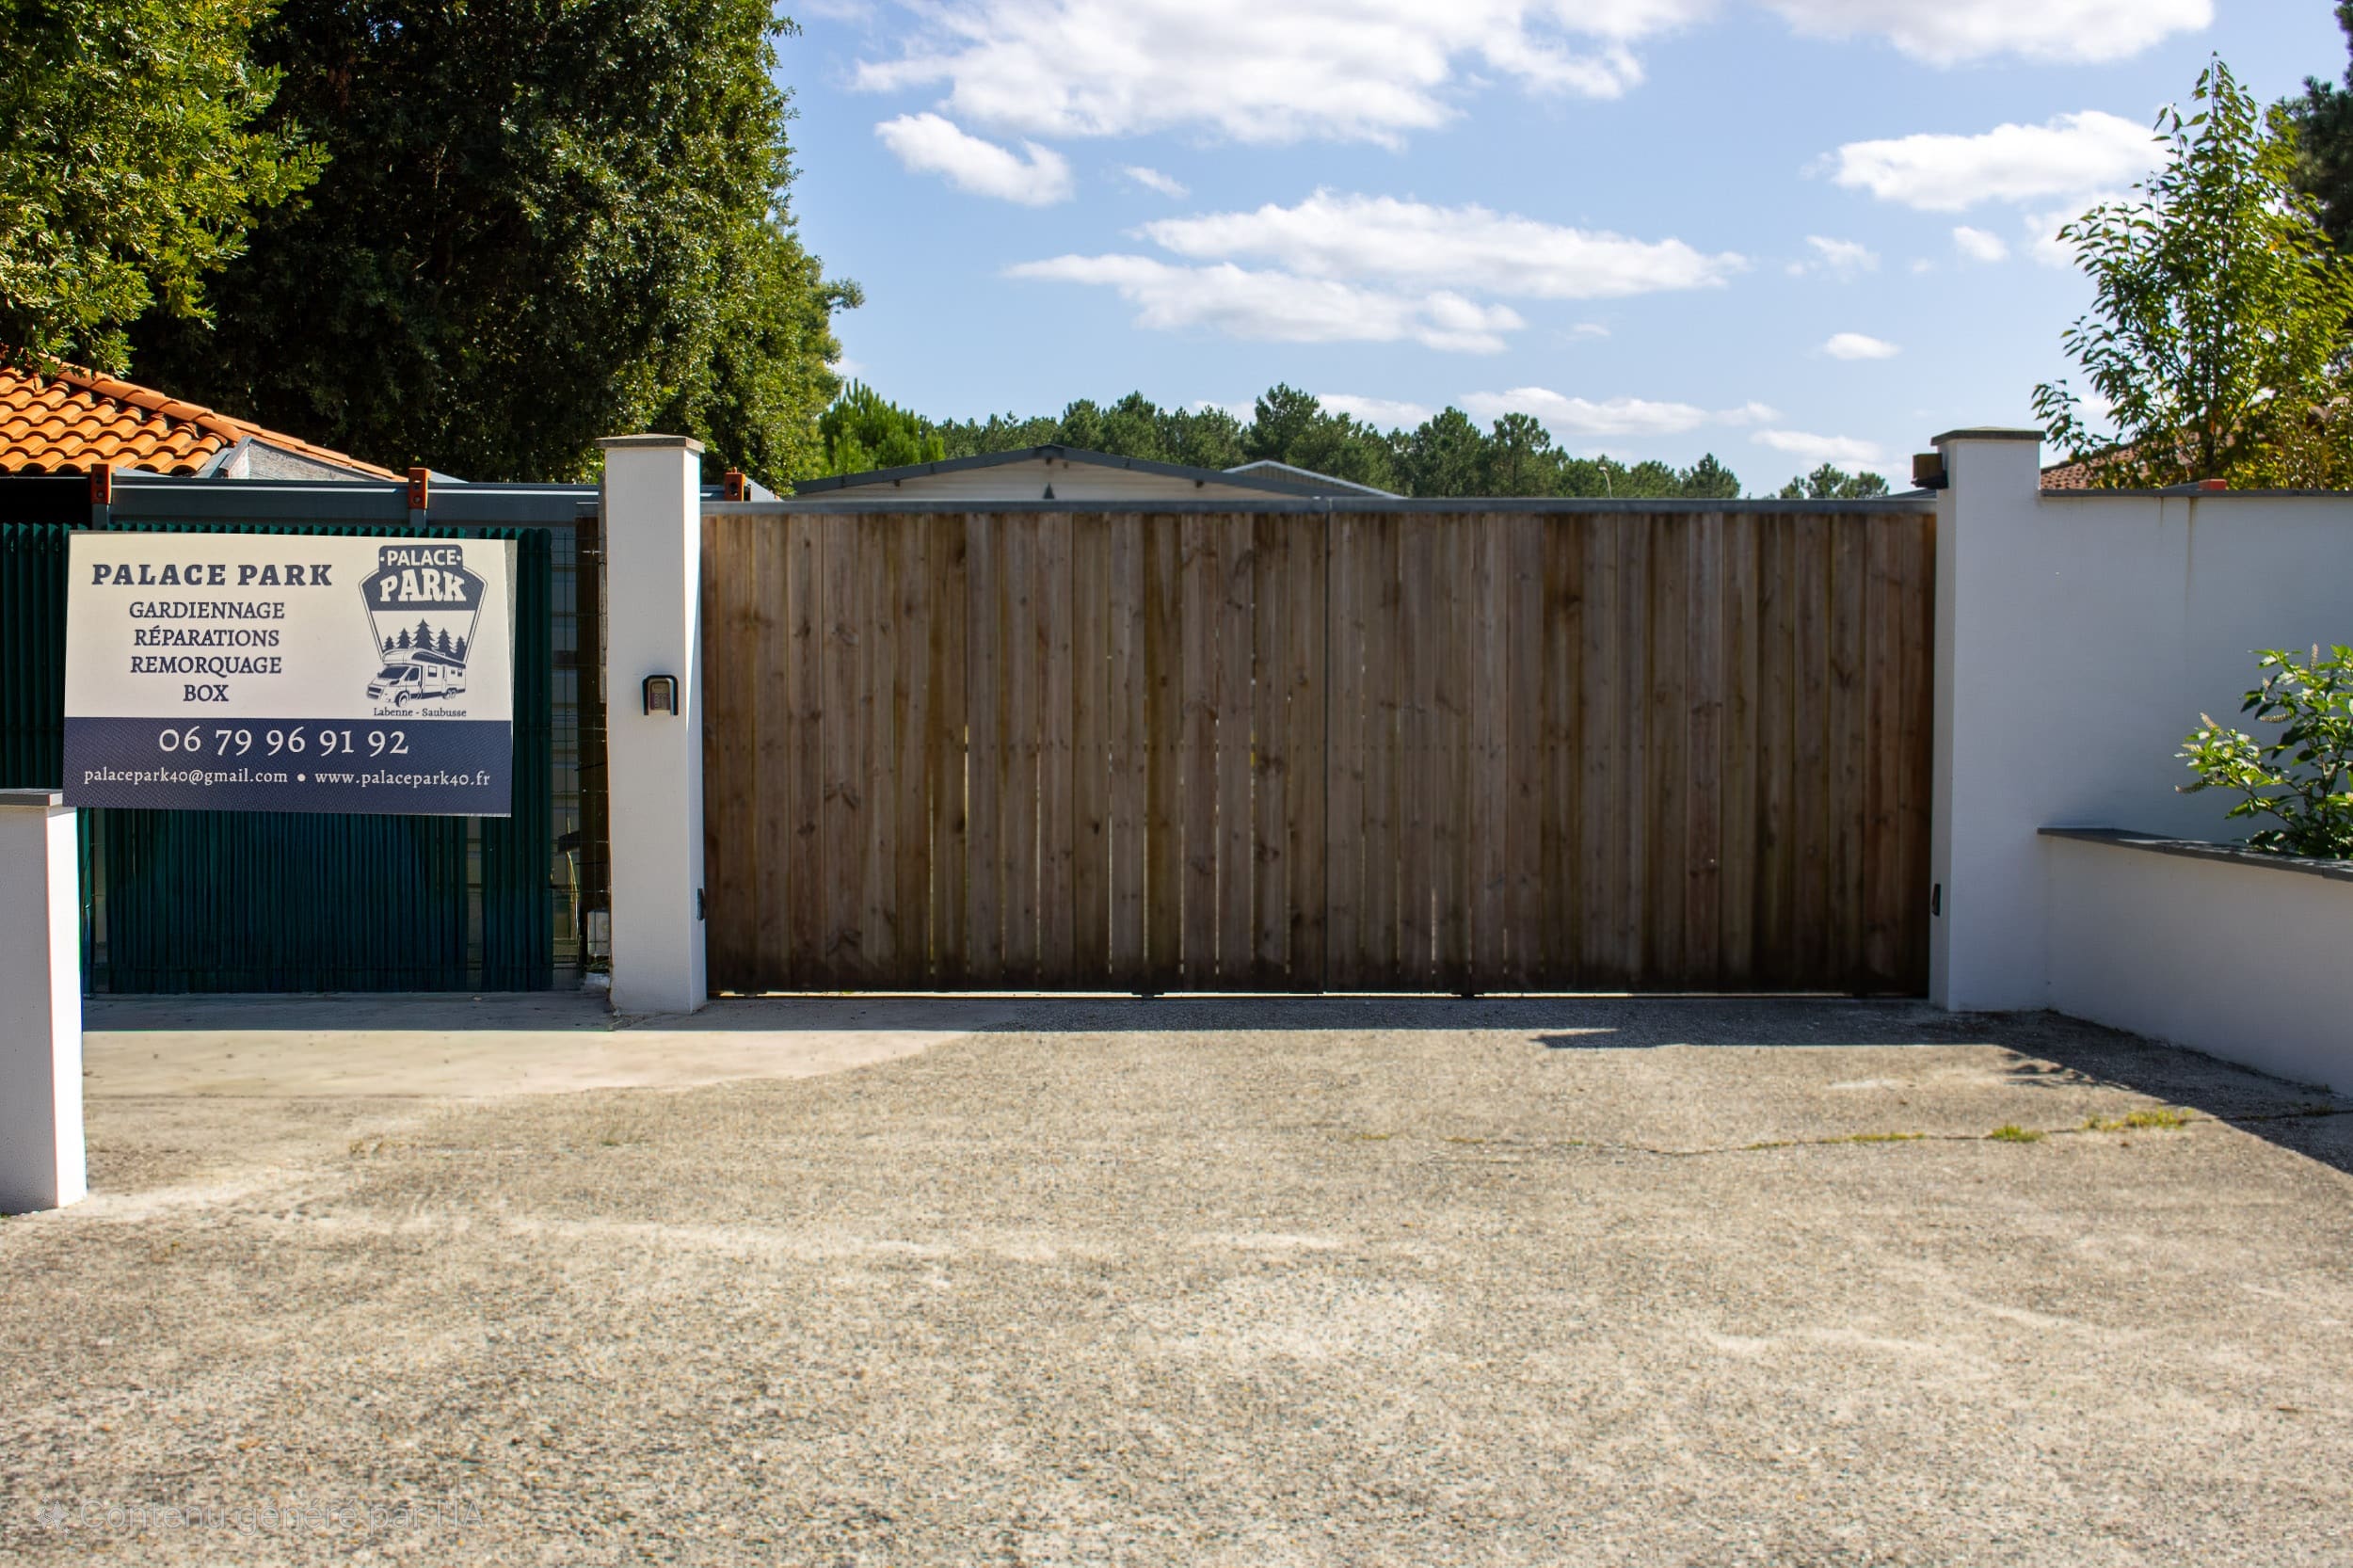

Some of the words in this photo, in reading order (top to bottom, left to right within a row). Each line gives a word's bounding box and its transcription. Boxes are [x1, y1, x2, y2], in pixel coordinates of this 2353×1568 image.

[387, 549, 456, 566] PALACE
[91, 564, 226, 585] PALACE
[237, 564, 332, 585] PARK
[379, 568, 467, 602] PARK
[129, 601, 285, 619] GARDIENNAGE
[134, 625, 280, 647] RÉPARATIONS
[130, 656, 282, 678] REMORQUAGE
[183, 684, 230, 702] BOX
[374, 707, 413, 717] Labenne
[422, 708, 467, 717] Saubusse
[159, 726, 201, 752] 06
[215, 729, 253, 757] 79
[265, 726, 307, 757] 96
[319, 729, 355, 757] 91
[367, 730, 409, 758] 92
[84, 766, 288, 786] palacepark40@gmail.com
[314, 770, 490, 789] www.palacepark40.fr
